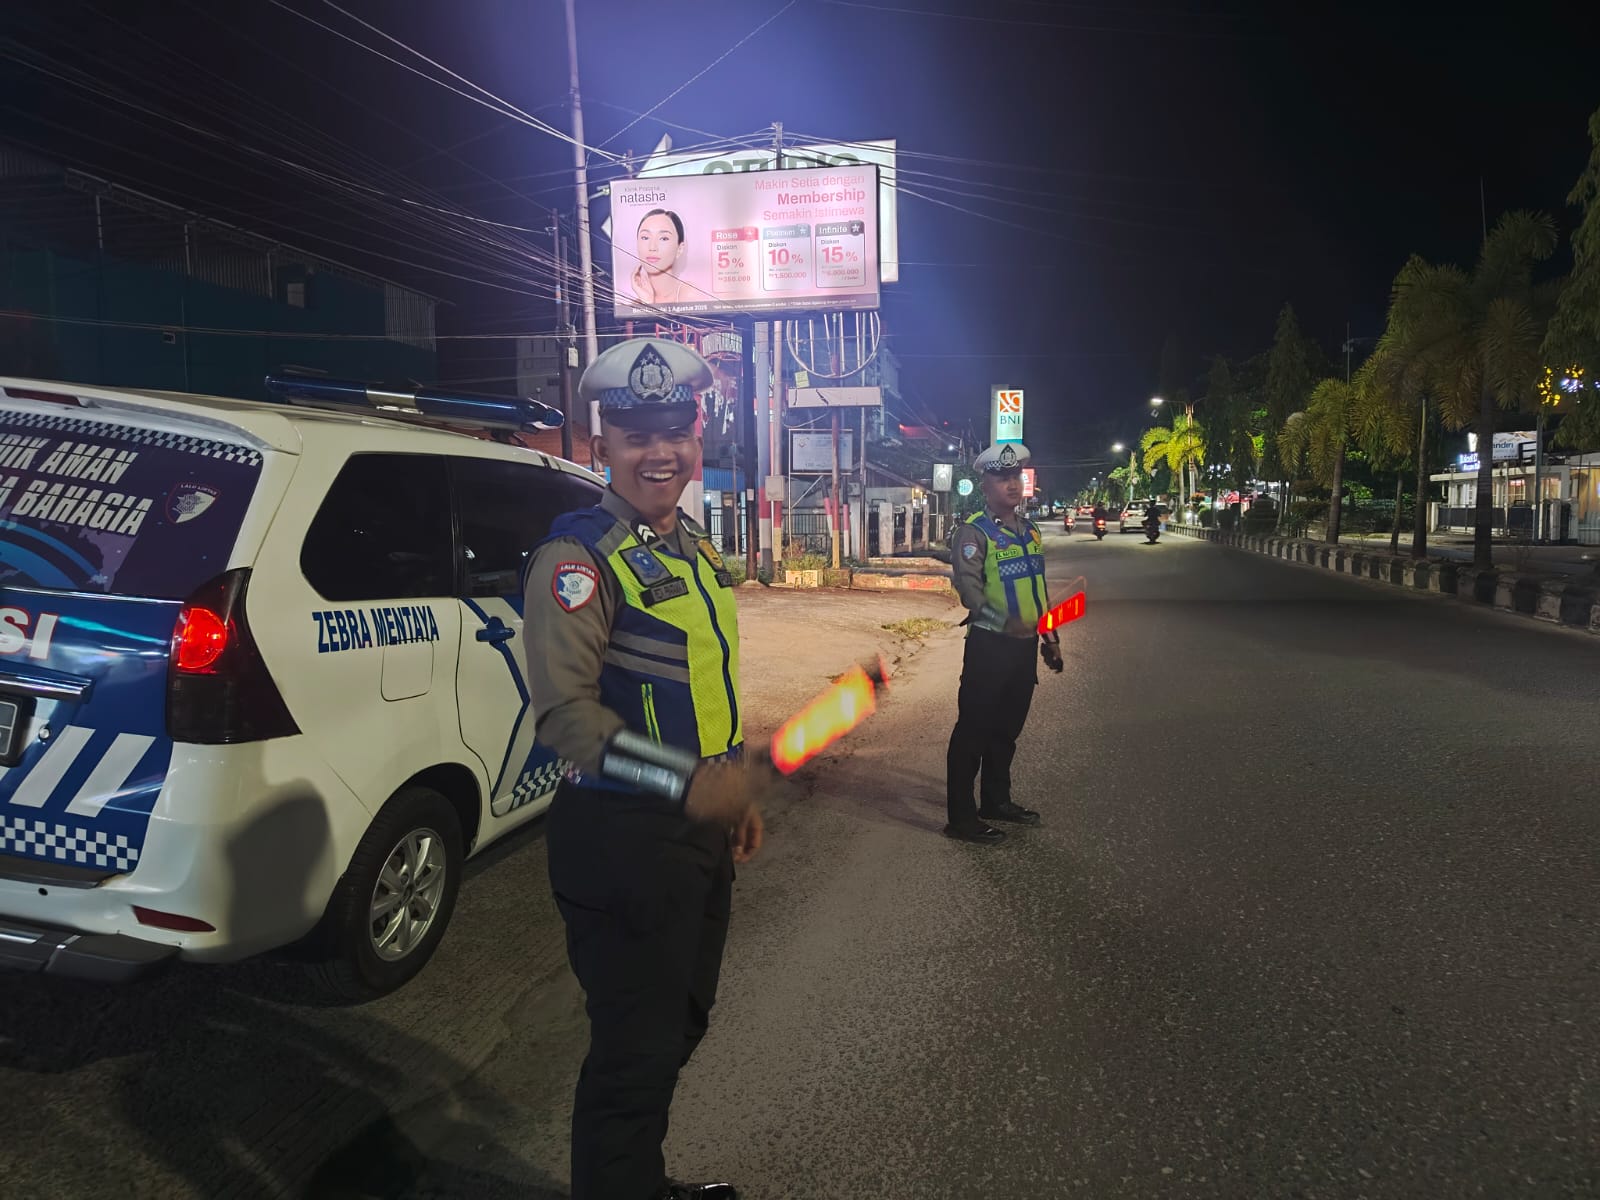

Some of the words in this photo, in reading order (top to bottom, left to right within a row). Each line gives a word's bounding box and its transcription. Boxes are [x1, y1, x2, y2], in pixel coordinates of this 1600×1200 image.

[755, 179, 789, 191] Makin
[791, 176, 820, 189] Setia
[822, 174, 865, 187] dengan
[620, 191, 666, 204] natasha
[777, 188, 866, 206] Membership
[763, 207, 812, 221] Semakin
[815, 205, 865, 218] Istimewa
[819, 225, 848, 235] Infinite
[1000, 415, 1020, 425] BNI
[37, 441, 139, 484] AMAN
[11, 480, 154, 535] BAHAGIA
[560, 563, 577, 571] LALU
[312, 608, 373, 653] ZEBRA
[370, 605, 440, 647] MENTAYA
